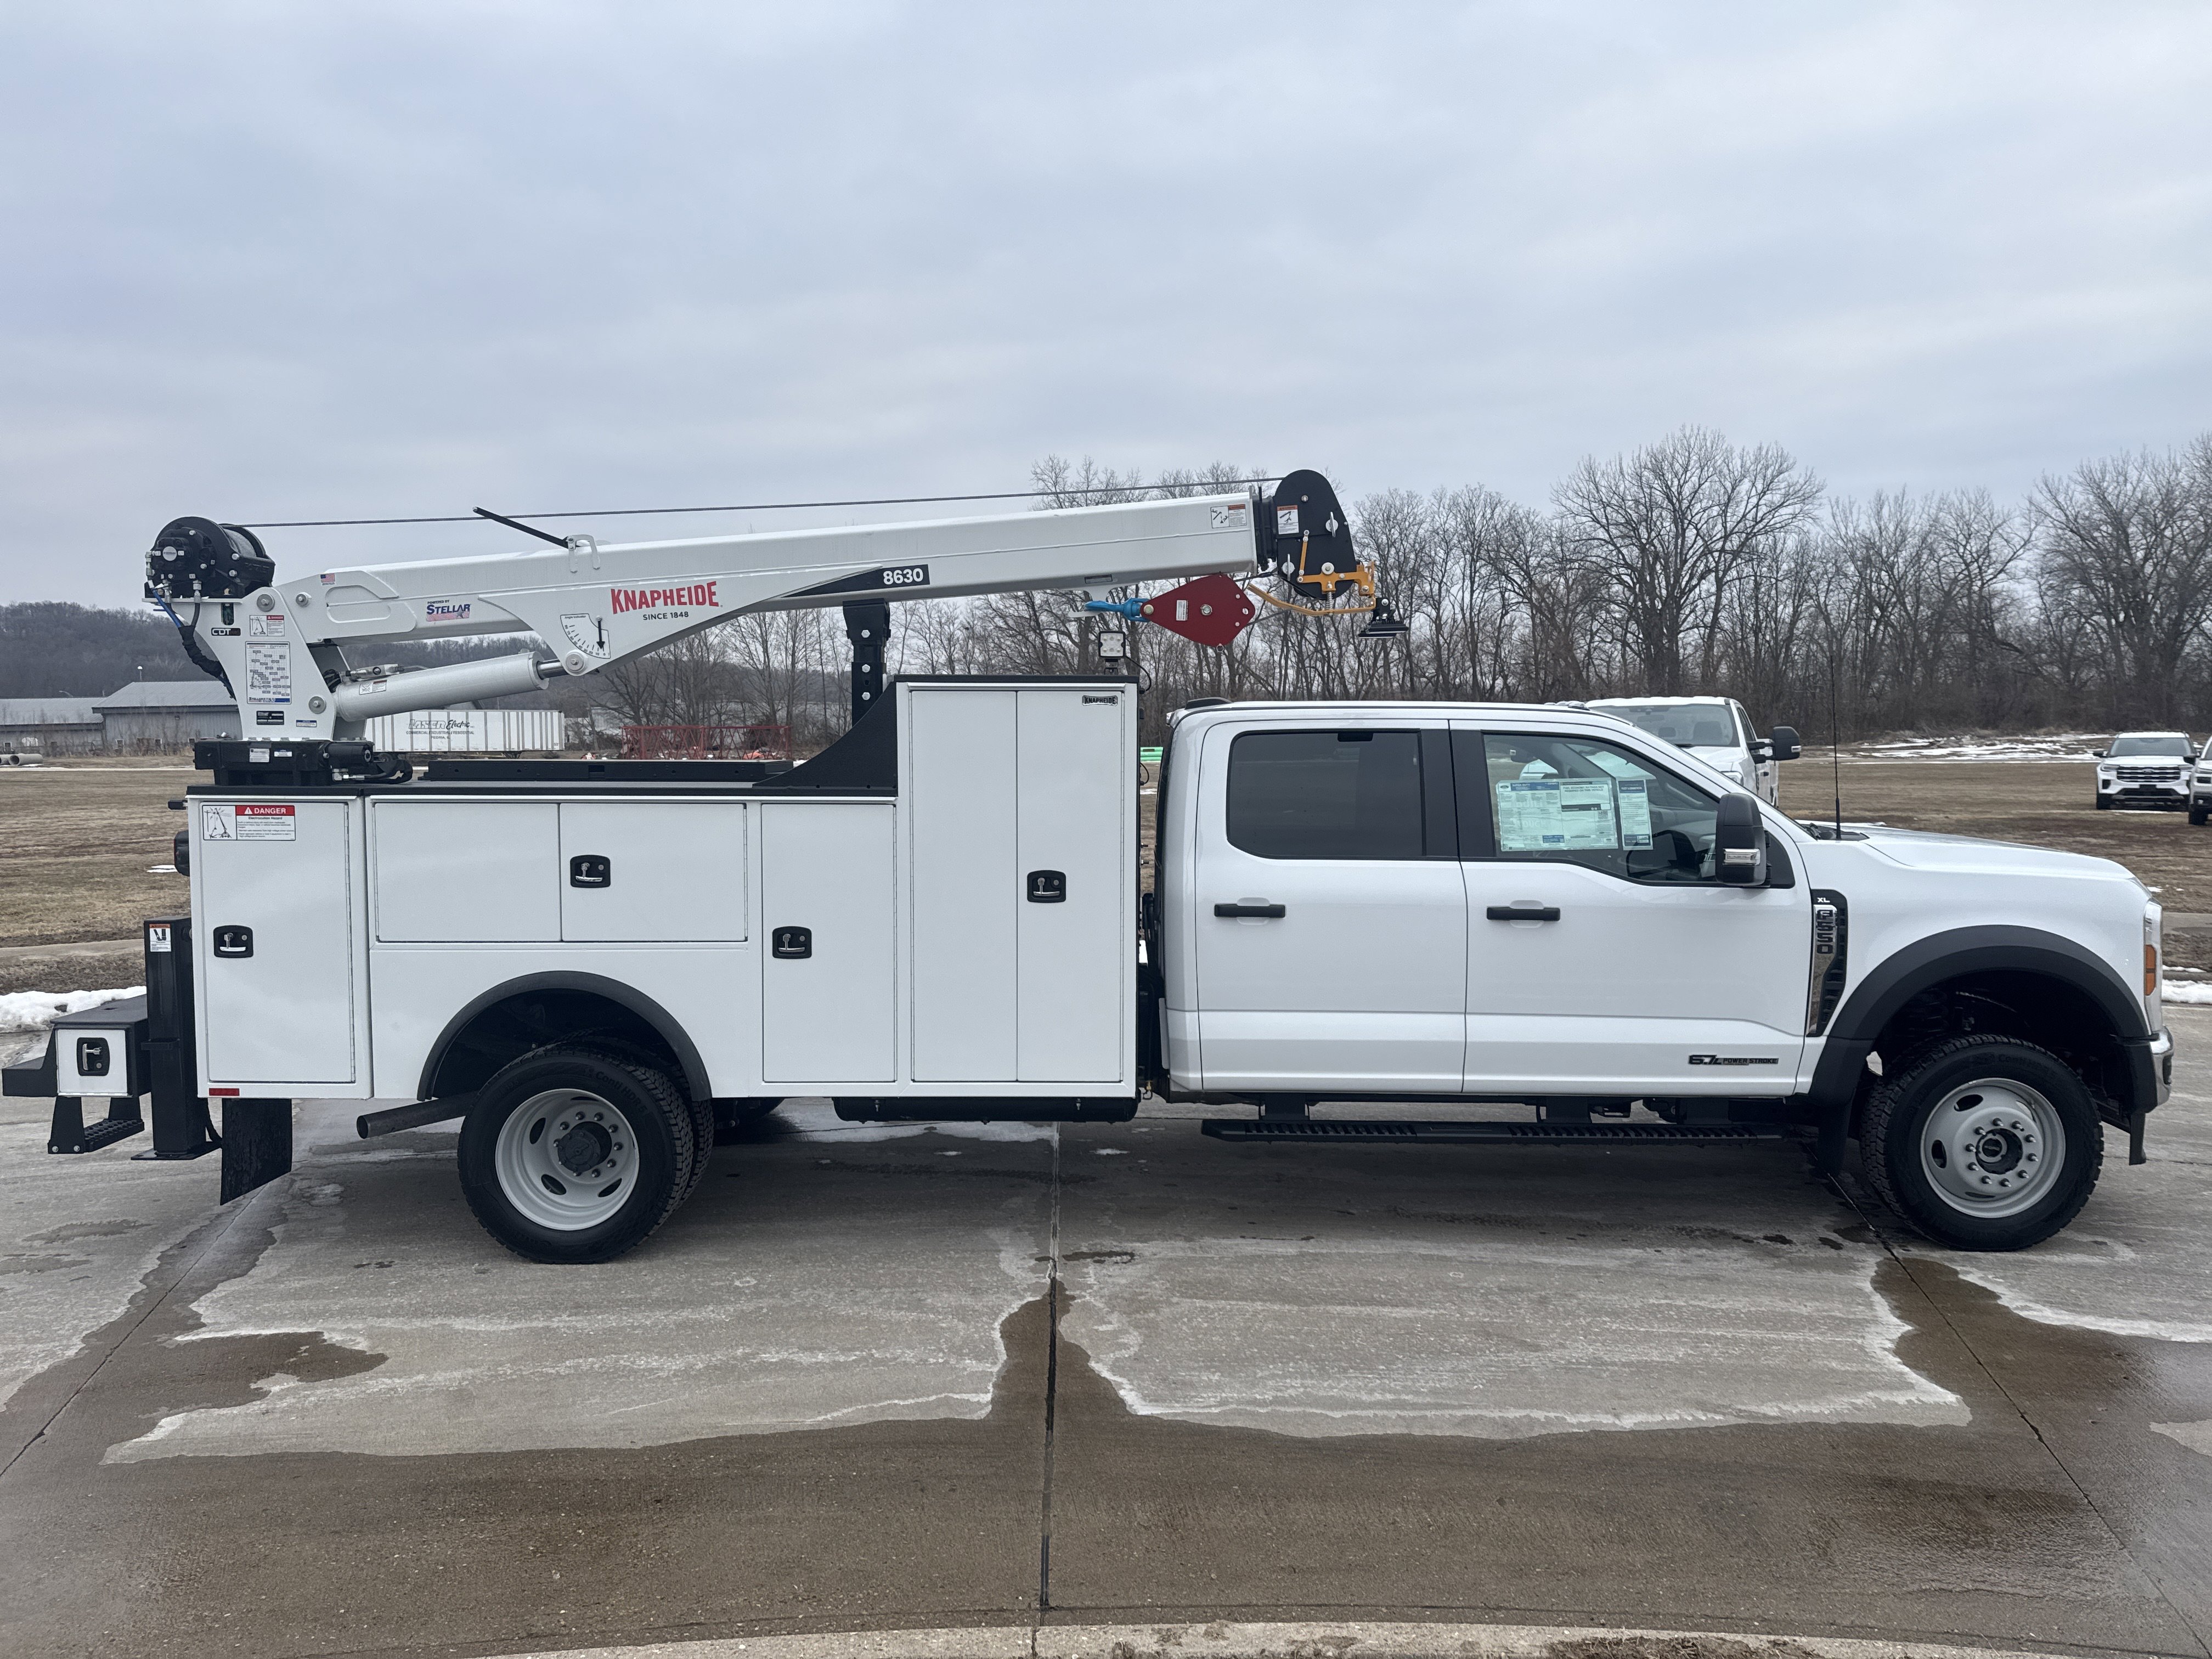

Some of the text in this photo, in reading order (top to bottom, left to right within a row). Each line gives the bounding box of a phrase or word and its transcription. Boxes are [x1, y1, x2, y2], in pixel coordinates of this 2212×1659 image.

[883, 568, 924, 585] 8630
[611, 581, 719, 614] KNAPHEIDE
[426, 604, 471, 615] STELLAR
[1085, 696, 1116, 704] KNAPHEIDE
[408, 719, 470, 730] LASER Electric
[1817, 910, 1833, 954] F550
[1689, 1054, 1722, 1065] 6.7L
